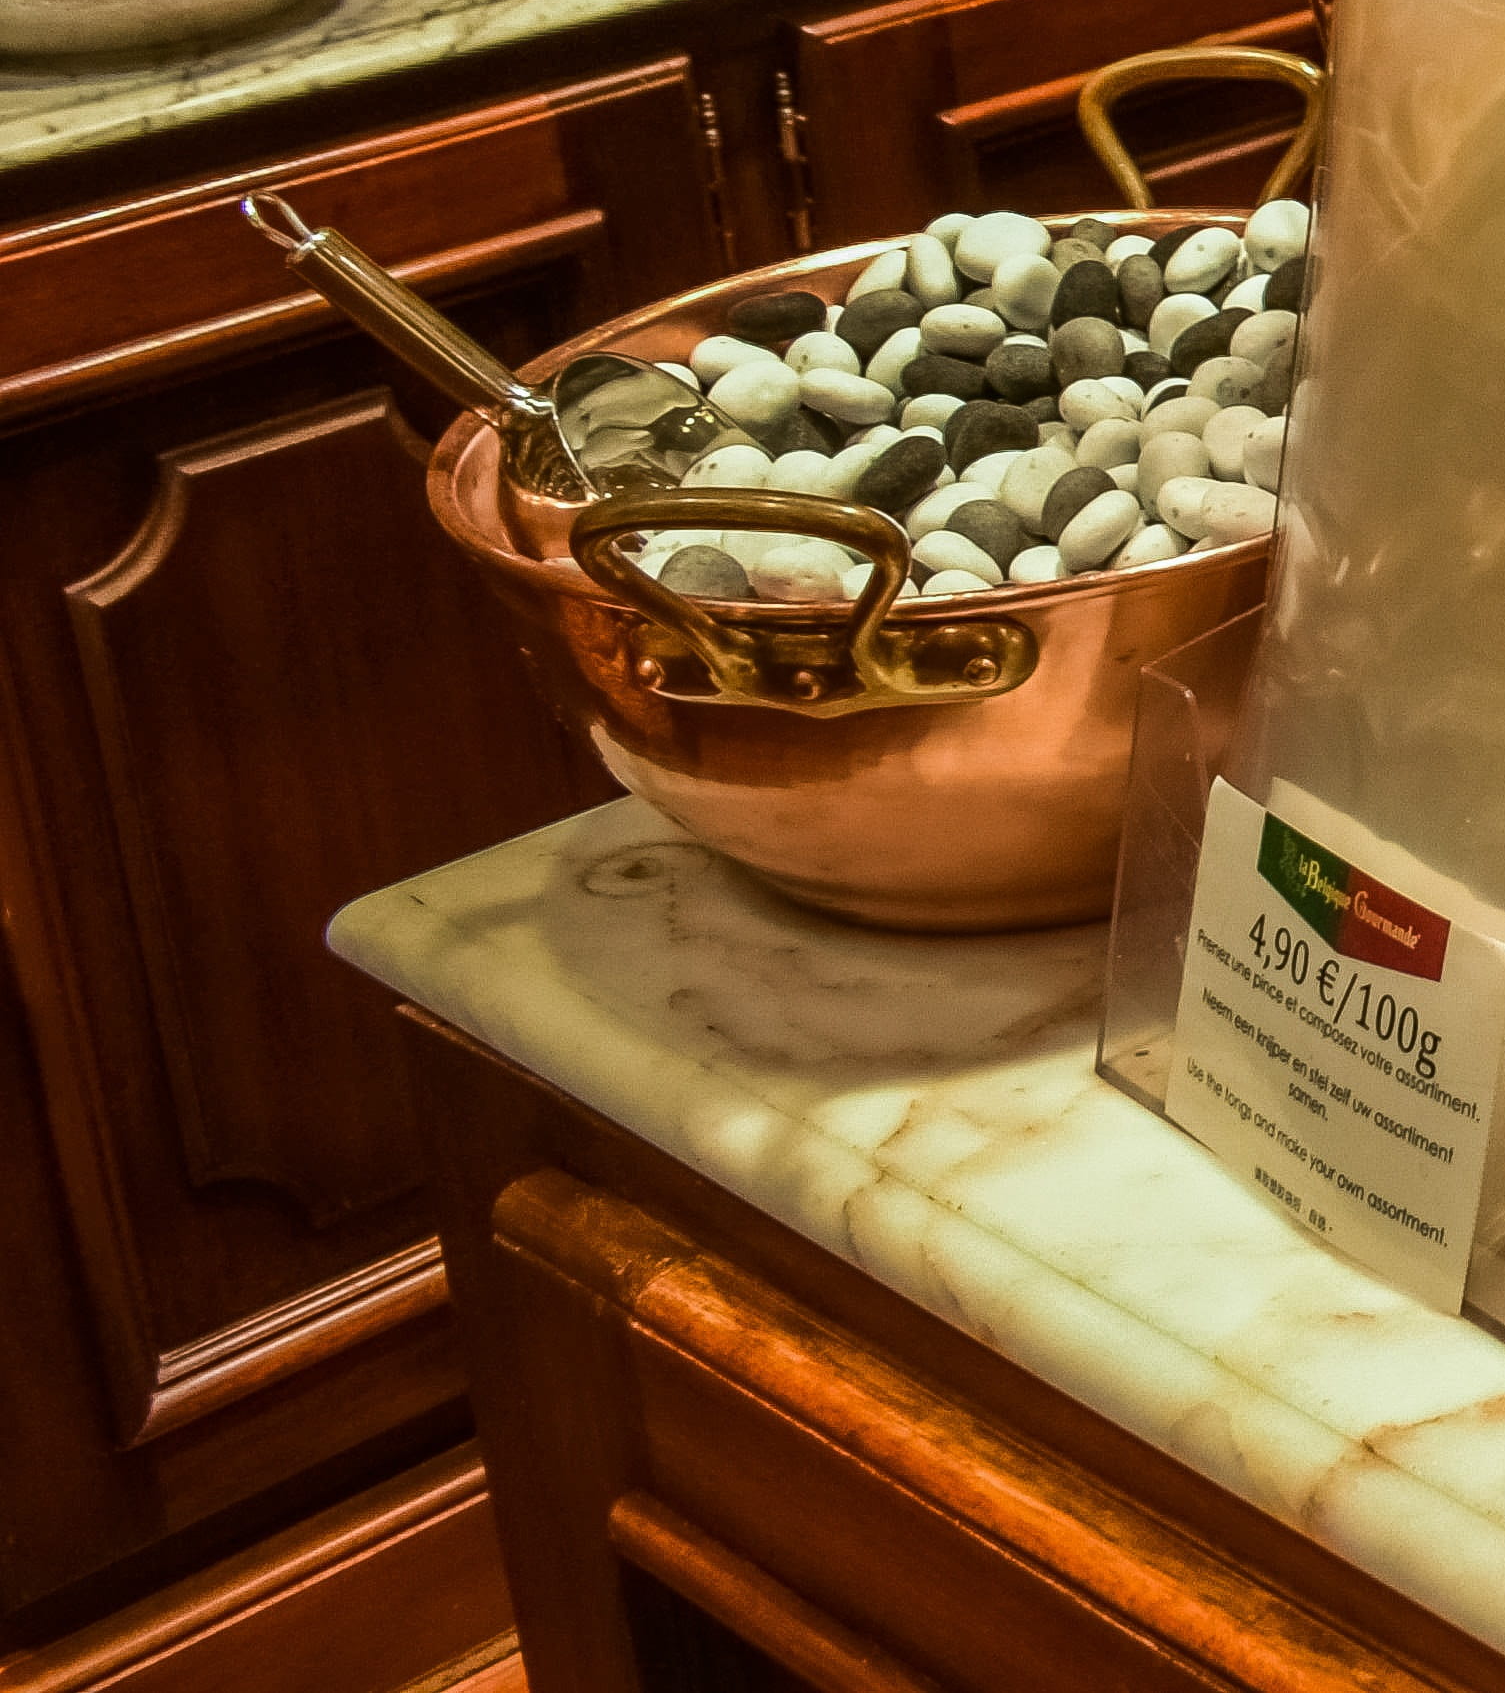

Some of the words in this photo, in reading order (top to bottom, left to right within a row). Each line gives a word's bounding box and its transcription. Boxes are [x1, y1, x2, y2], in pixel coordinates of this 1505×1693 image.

[1248, 913, 1311, 985] 4,90
[1299, 853, 1309, 877] la
[1305, 860, 1352, 911] Belgique
[1354, 890, 1422, 951] Gourmande
[1197, 927, 1231, 967] Prenez
[1231, 955, 1252, 982] une
[1252, 971, 1285, 1005] pince
[1285, 996, 1299, 1014] et
[1299, 1005, 1359, 1056] composez
[1360, 1045, 1394, 1076] votre
[1202, 986, 1234, 1022] Neem
[1234, 1013, 1256, 1042] een
[1255, 1026, 1293, 1066] knijper
[1292, 1057, 1308, 1078] en
[1308, 1067, 1330, 1092] stel
[1329, 1081, 1352, 1106] zelf
[1352, 1097, 1373, 1120] uw
[1374, 1110, 1455, 1165] assortiment
[1186, 1056, 1205, 1083] Use
[1206, 1071, 1224, 1097] the
[1224, 1086, 1253, 1122] tongs
[1253, 1112, 1276, 1139] and
[1276, 1129, 1309, 1163] make
[1309, 1153, 1337, 1182] your
[1337, 1173, 1365, 1201] own
[1366, 1192, 1448, 1248] assortment.
